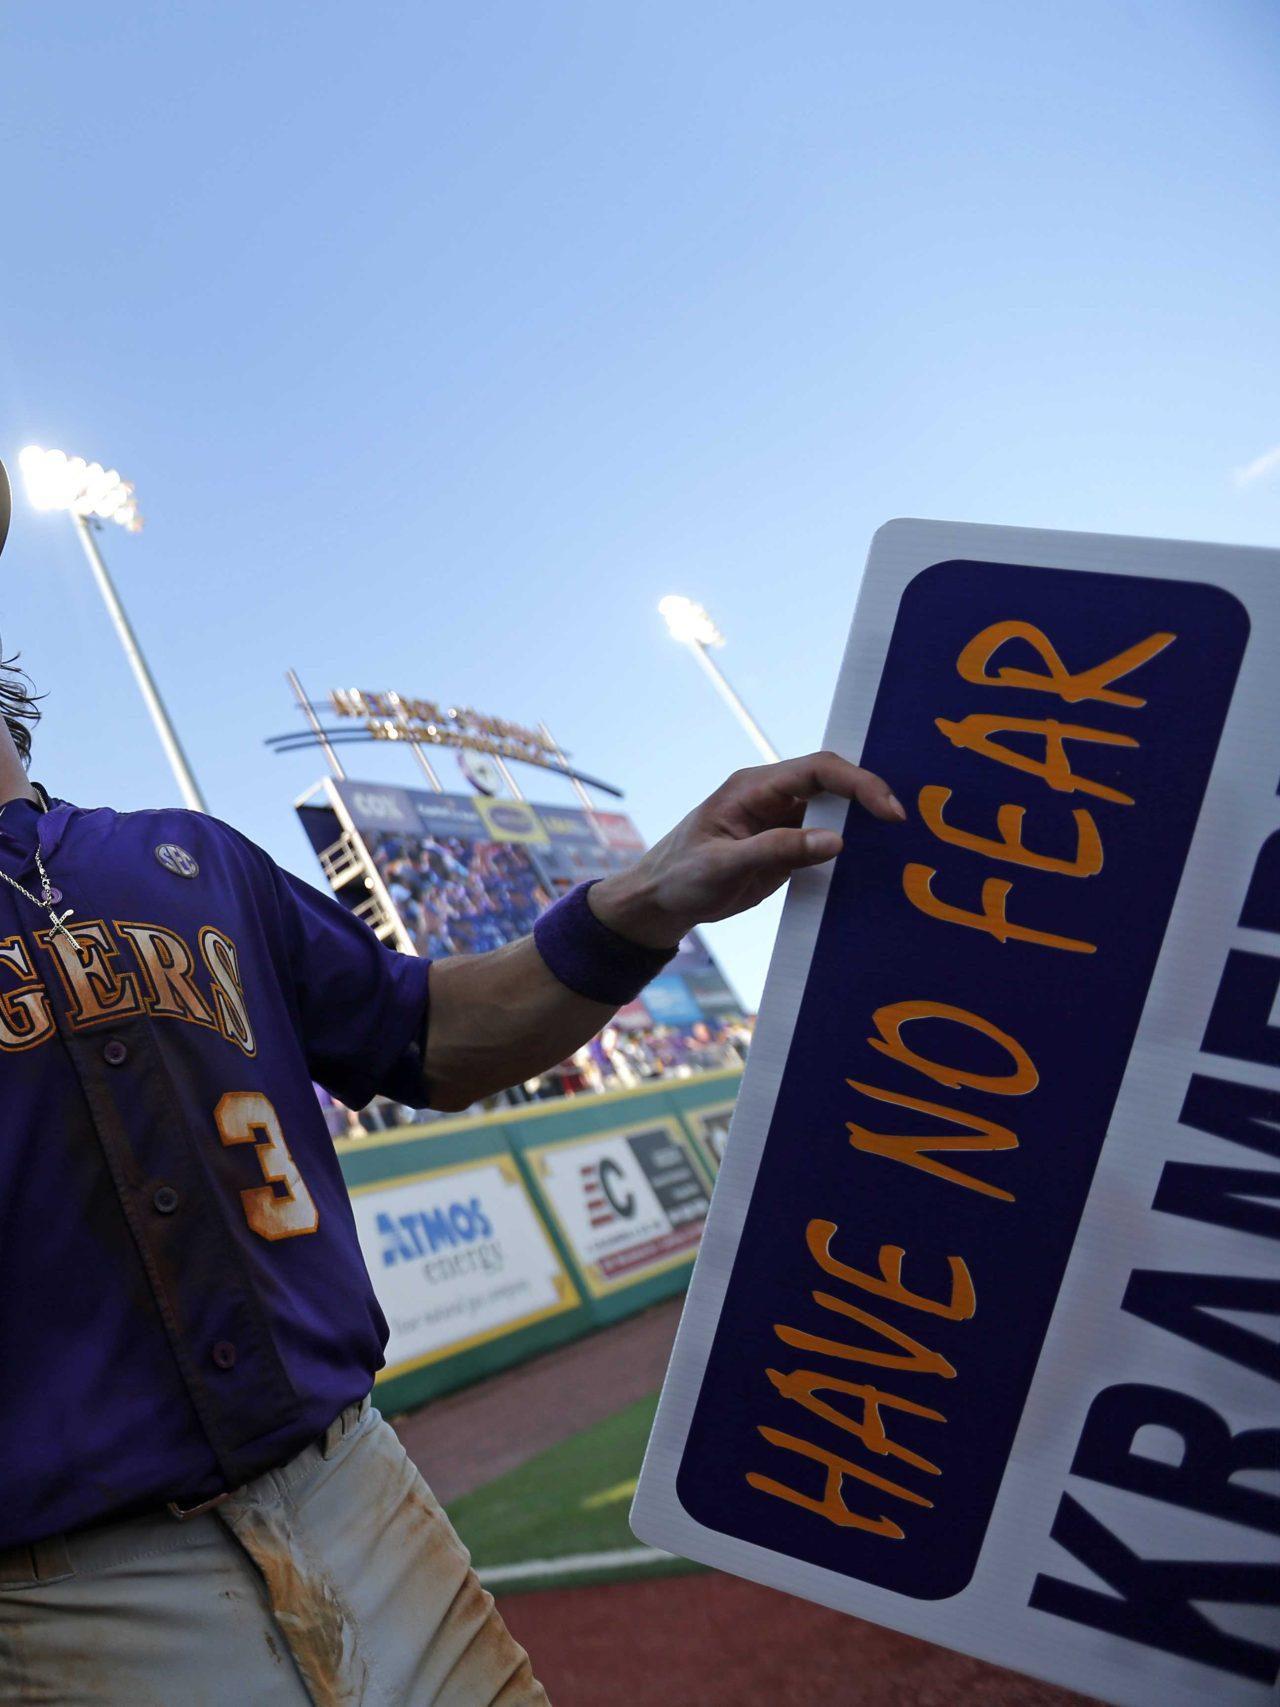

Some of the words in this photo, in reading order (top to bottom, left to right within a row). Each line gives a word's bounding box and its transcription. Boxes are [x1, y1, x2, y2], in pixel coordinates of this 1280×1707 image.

[158, 846, 197, 876] SEC
[902, 619, 1178, 955] FEAR
[213, 1091, 320, 1242] 3
[844, 998, 1041, 1203] NO
[376, 1195, 494, 1268] ATMOS
[424, 1241, 504, 1284] energy
[745, 1218, 977, 1542] HAVE
